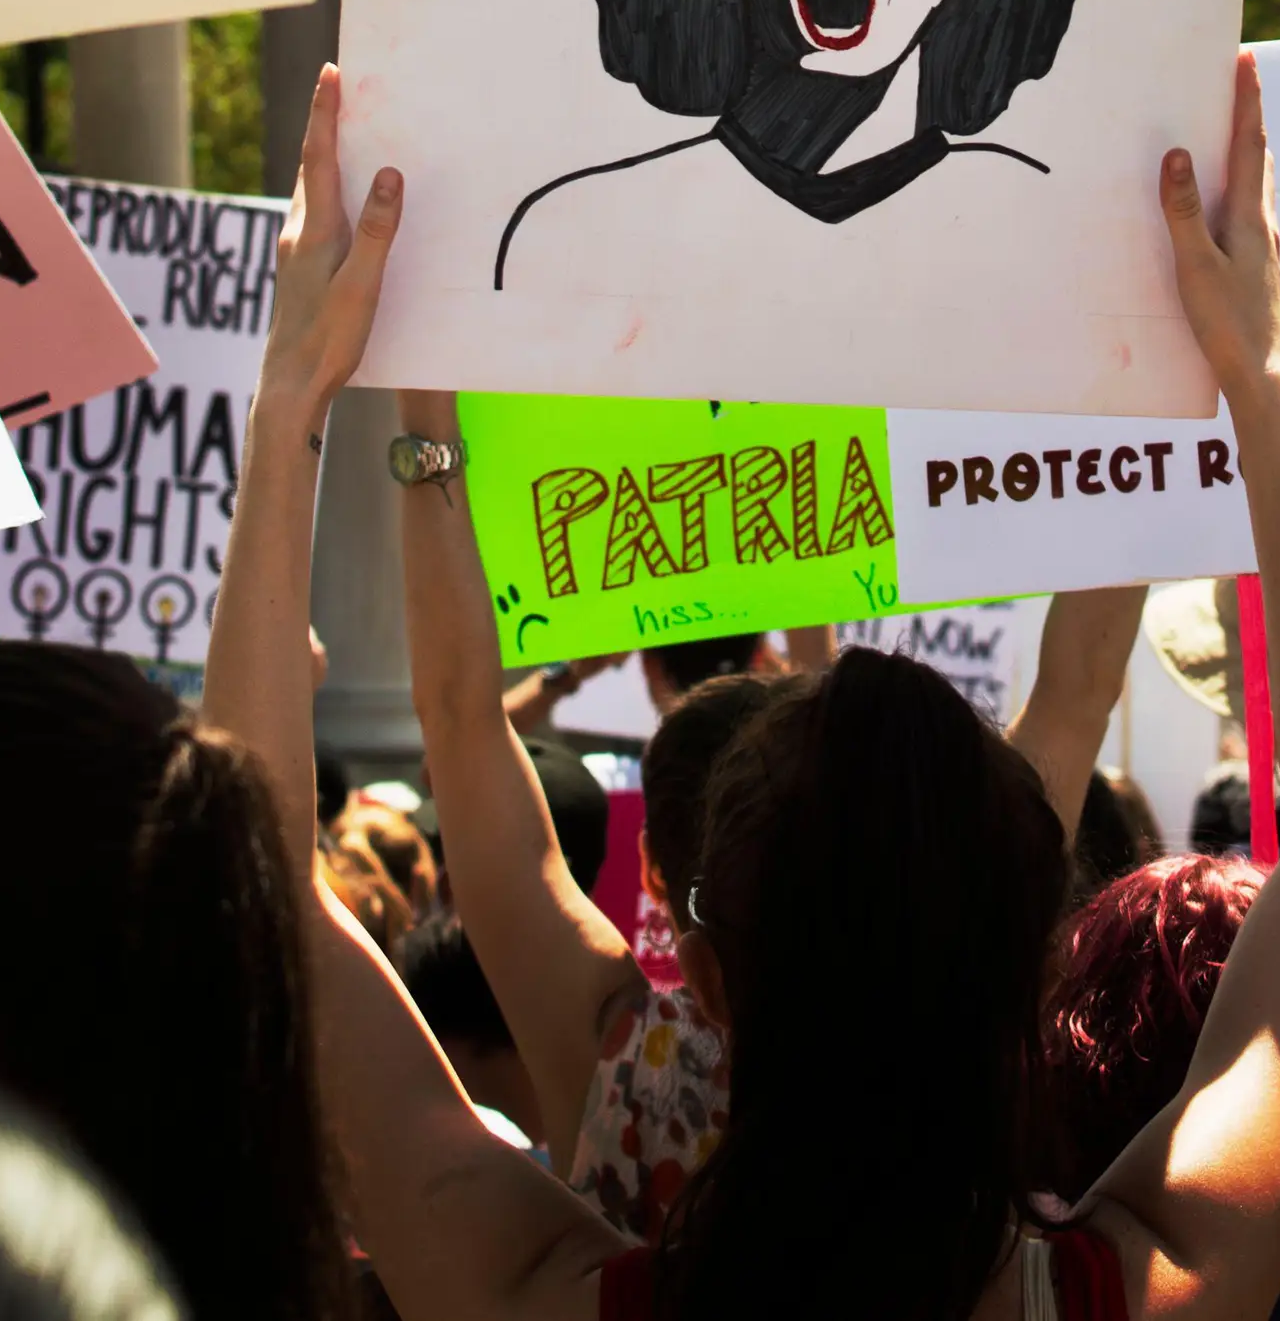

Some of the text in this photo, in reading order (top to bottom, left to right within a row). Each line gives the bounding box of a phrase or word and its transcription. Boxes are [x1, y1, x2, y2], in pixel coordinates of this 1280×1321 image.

[46, 181, 286, 262] EPRODUCTI
[163, 258, 276, 336] RIGH
[19, 375, 254, 479] HUMA
[926, 441, 1175, 508] PROTECT
